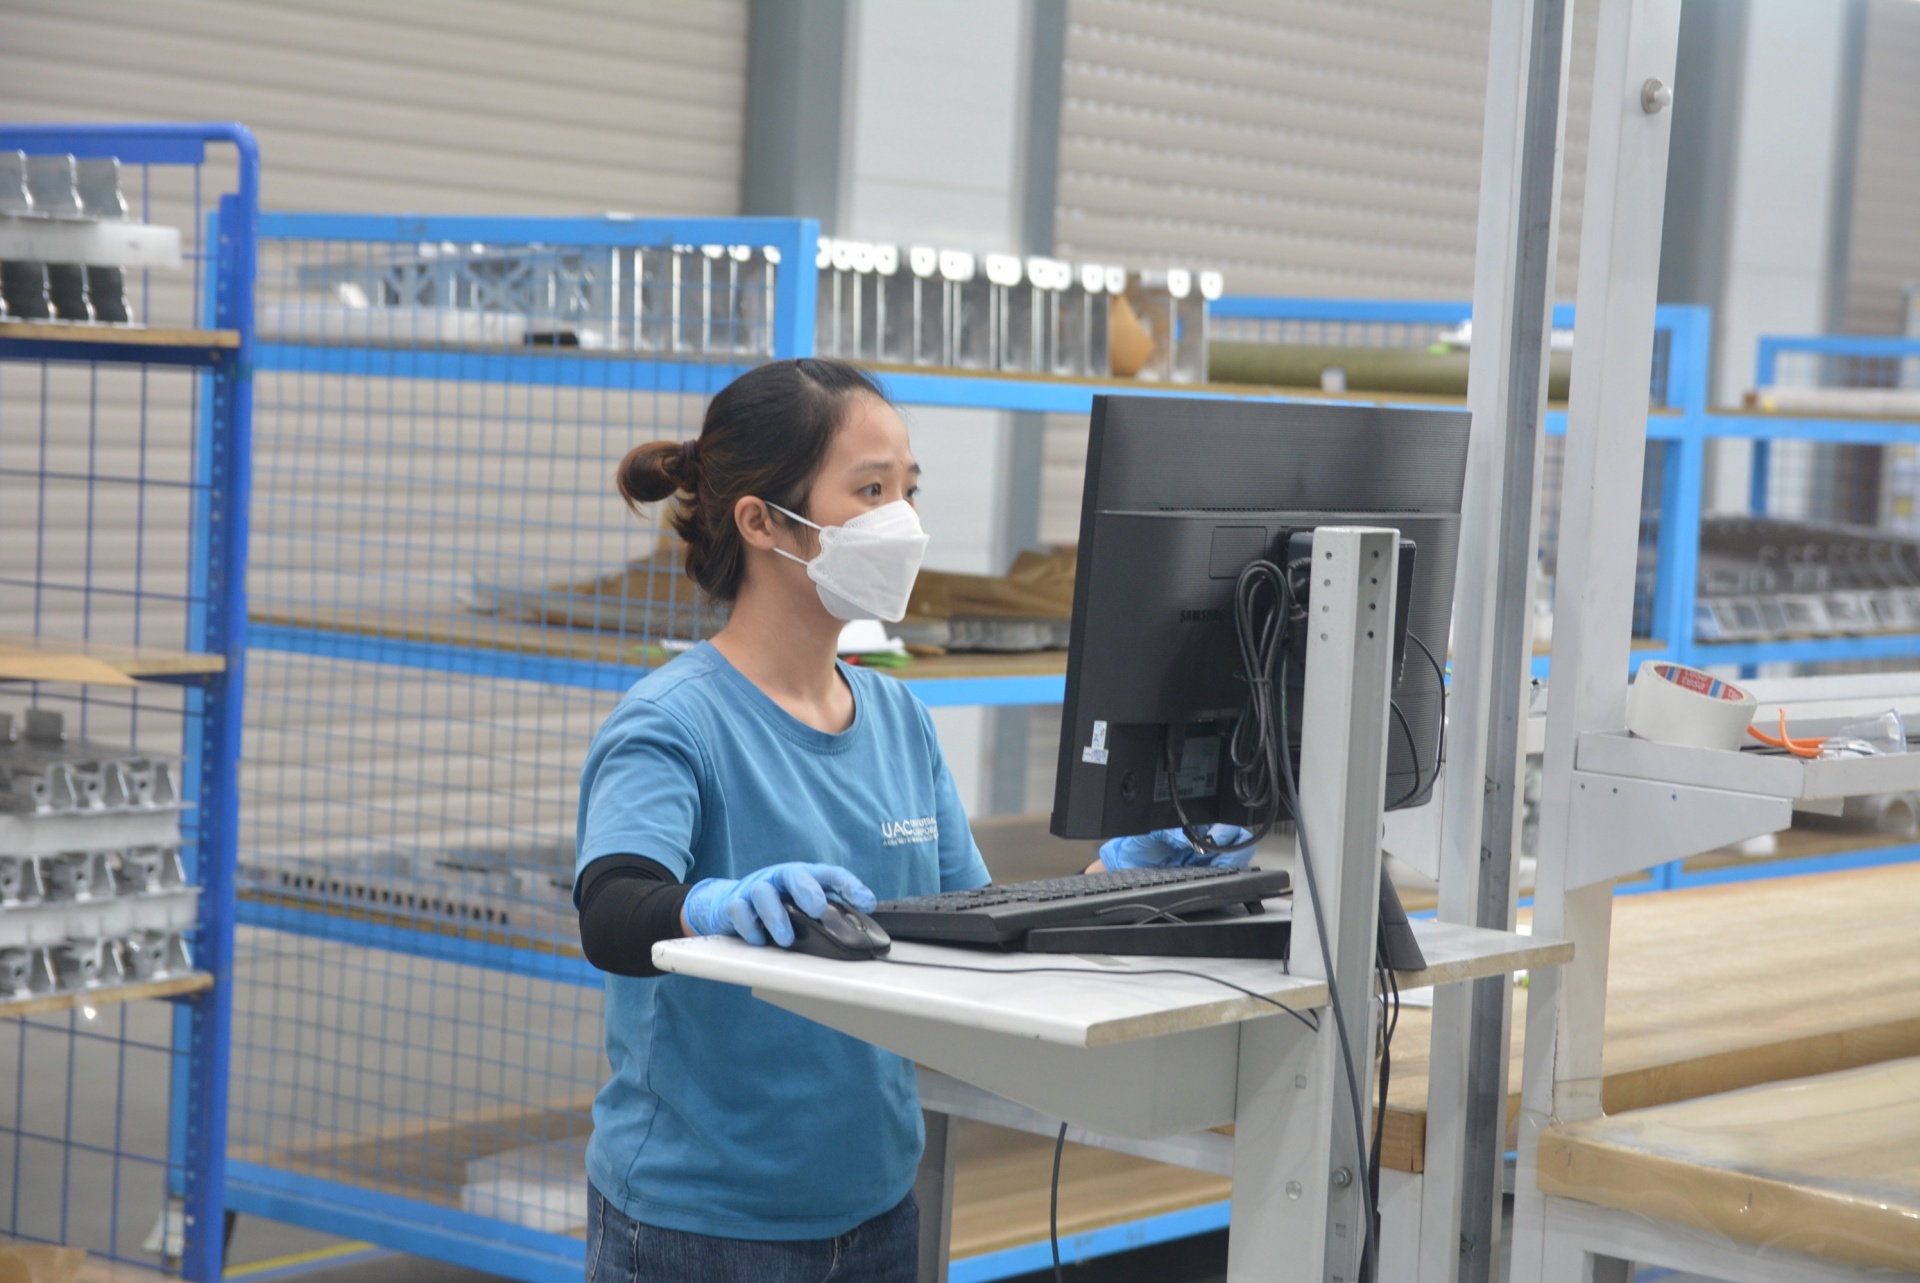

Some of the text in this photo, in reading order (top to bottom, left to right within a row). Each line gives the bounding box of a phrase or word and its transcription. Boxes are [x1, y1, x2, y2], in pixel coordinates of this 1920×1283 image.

[1179, 609, 1225, 623] SAMSUNG
[1682, 676, 1706, 691] tesa
[881, 819, 912, 838] UAC
